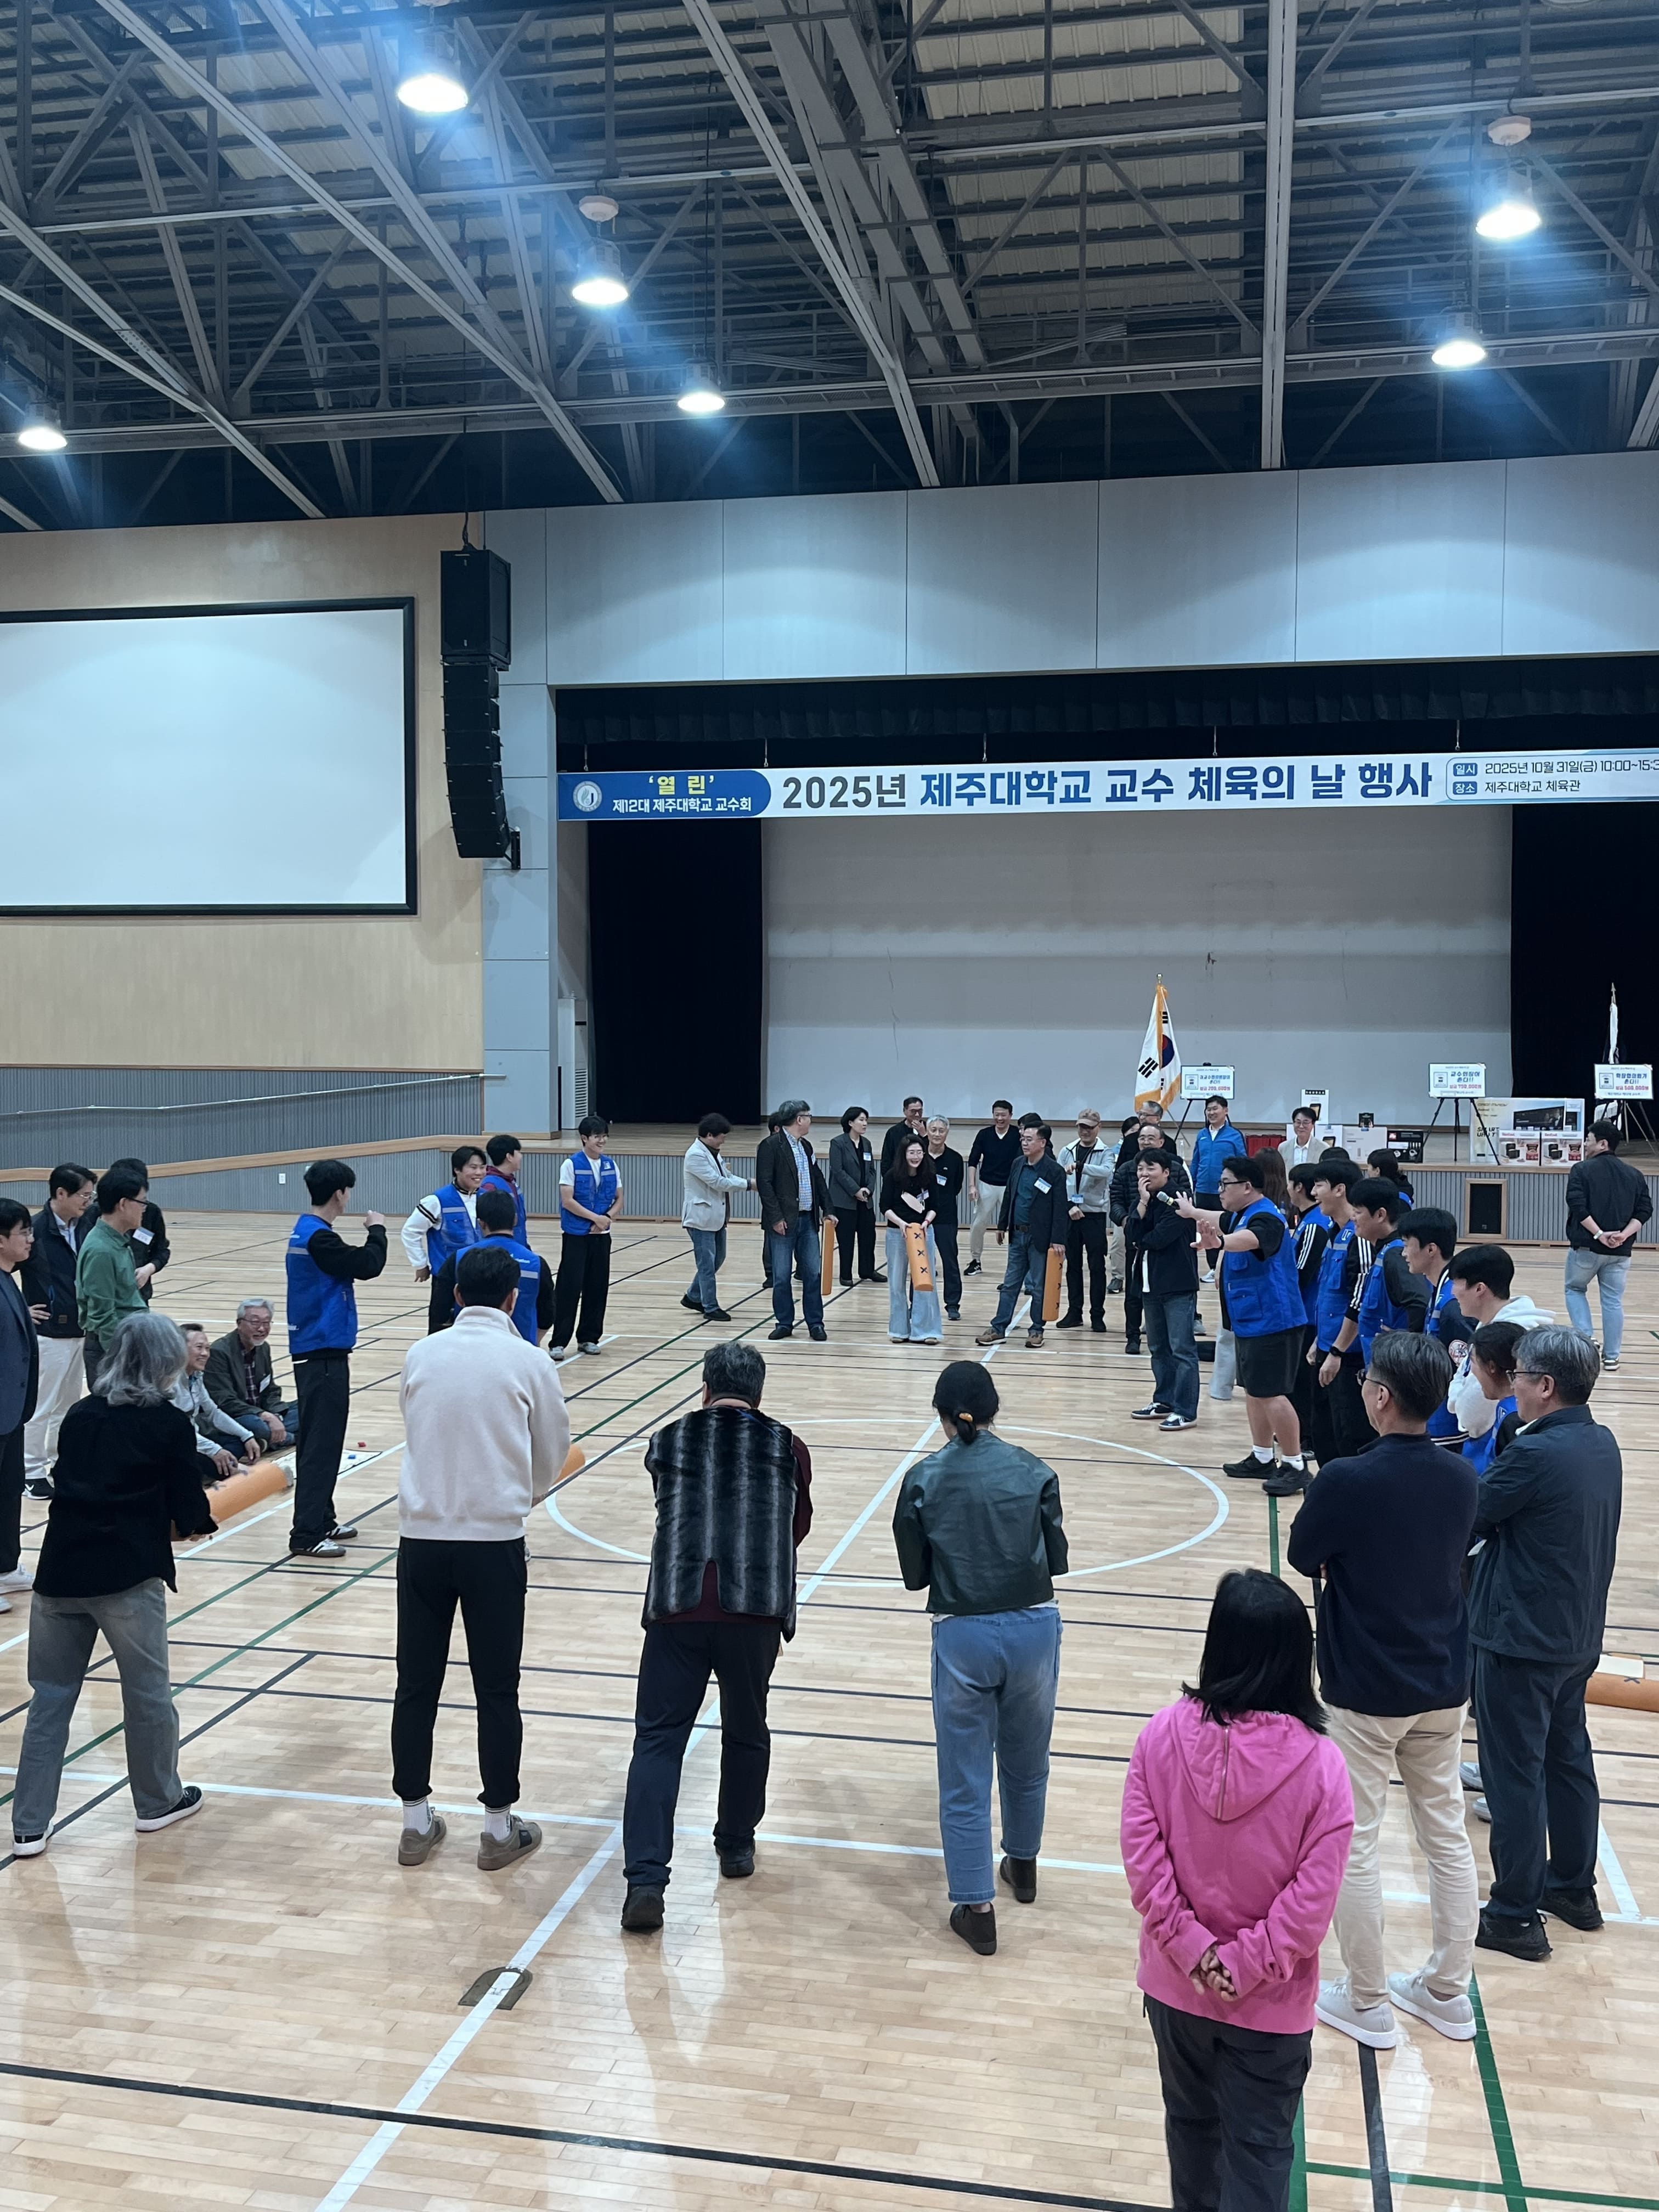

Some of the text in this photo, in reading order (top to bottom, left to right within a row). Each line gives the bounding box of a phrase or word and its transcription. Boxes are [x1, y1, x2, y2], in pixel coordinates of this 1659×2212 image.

[1455, 764, 1475, 775] 일시
[1485, 761, 1528, 774] 2025년
[1531, 761, 1554, 774] 10월
[1556, 760, 1598, 773] 31일(금)
[783, 761, 1432, 809] 2025년 제주대학교 교수 체육의 날 행사
[1455, 780, 1581, 794] 장소 제주대학교 체육관
[612, 797, 751, 814] 제12대 제주대학교 교수회
